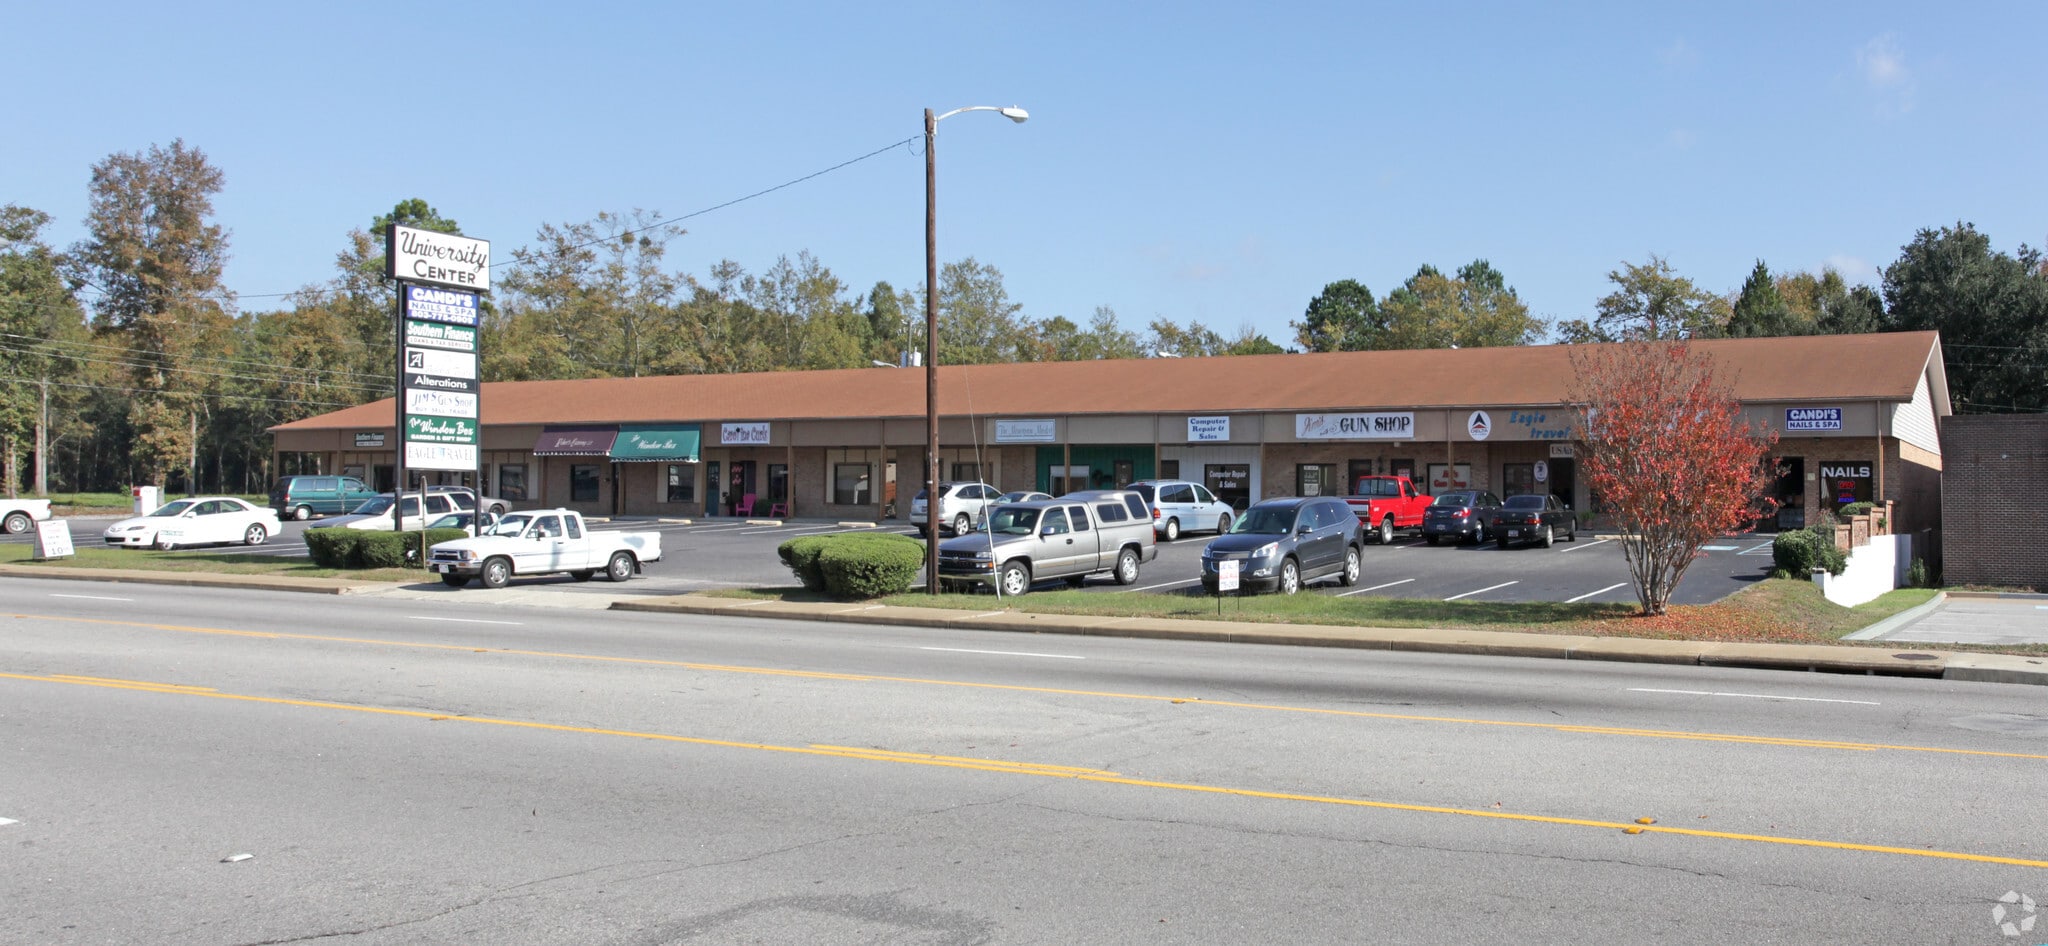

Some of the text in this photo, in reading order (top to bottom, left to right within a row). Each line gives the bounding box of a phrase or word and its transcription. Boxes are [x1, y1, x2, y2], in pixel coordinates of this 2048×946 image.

[401, 231, 487, 273] University
[413, 259, 476, 284] CENTER
[412, 287, 473, 307] CANDI'S
[411, 301, 441, 311] NAILS
[454, 307, 473, 316] SPA
[408, 321, 475, 342] Southern Finance
[410, 353, 423, 367] A
[414, 374, 468, 389] Alterations
[1509, 410, 1547, 426] Eagle
[1790, 409, 1838, 420] CANDI'S
[409, 417, 474, 436] The Window Box
[1340, 417, 1369, 432] GUN
[1374, 416, 1410, 432] SHOP
[637, 439, 661, 449] Window
[408, 446, 473, 461] EAGLE TRAVEL
[1209, 470, 1247, 478] Computer Repair
[1821, 466, 1870, 477] NAILS
[1434, 479, 1448, 488] Gun
